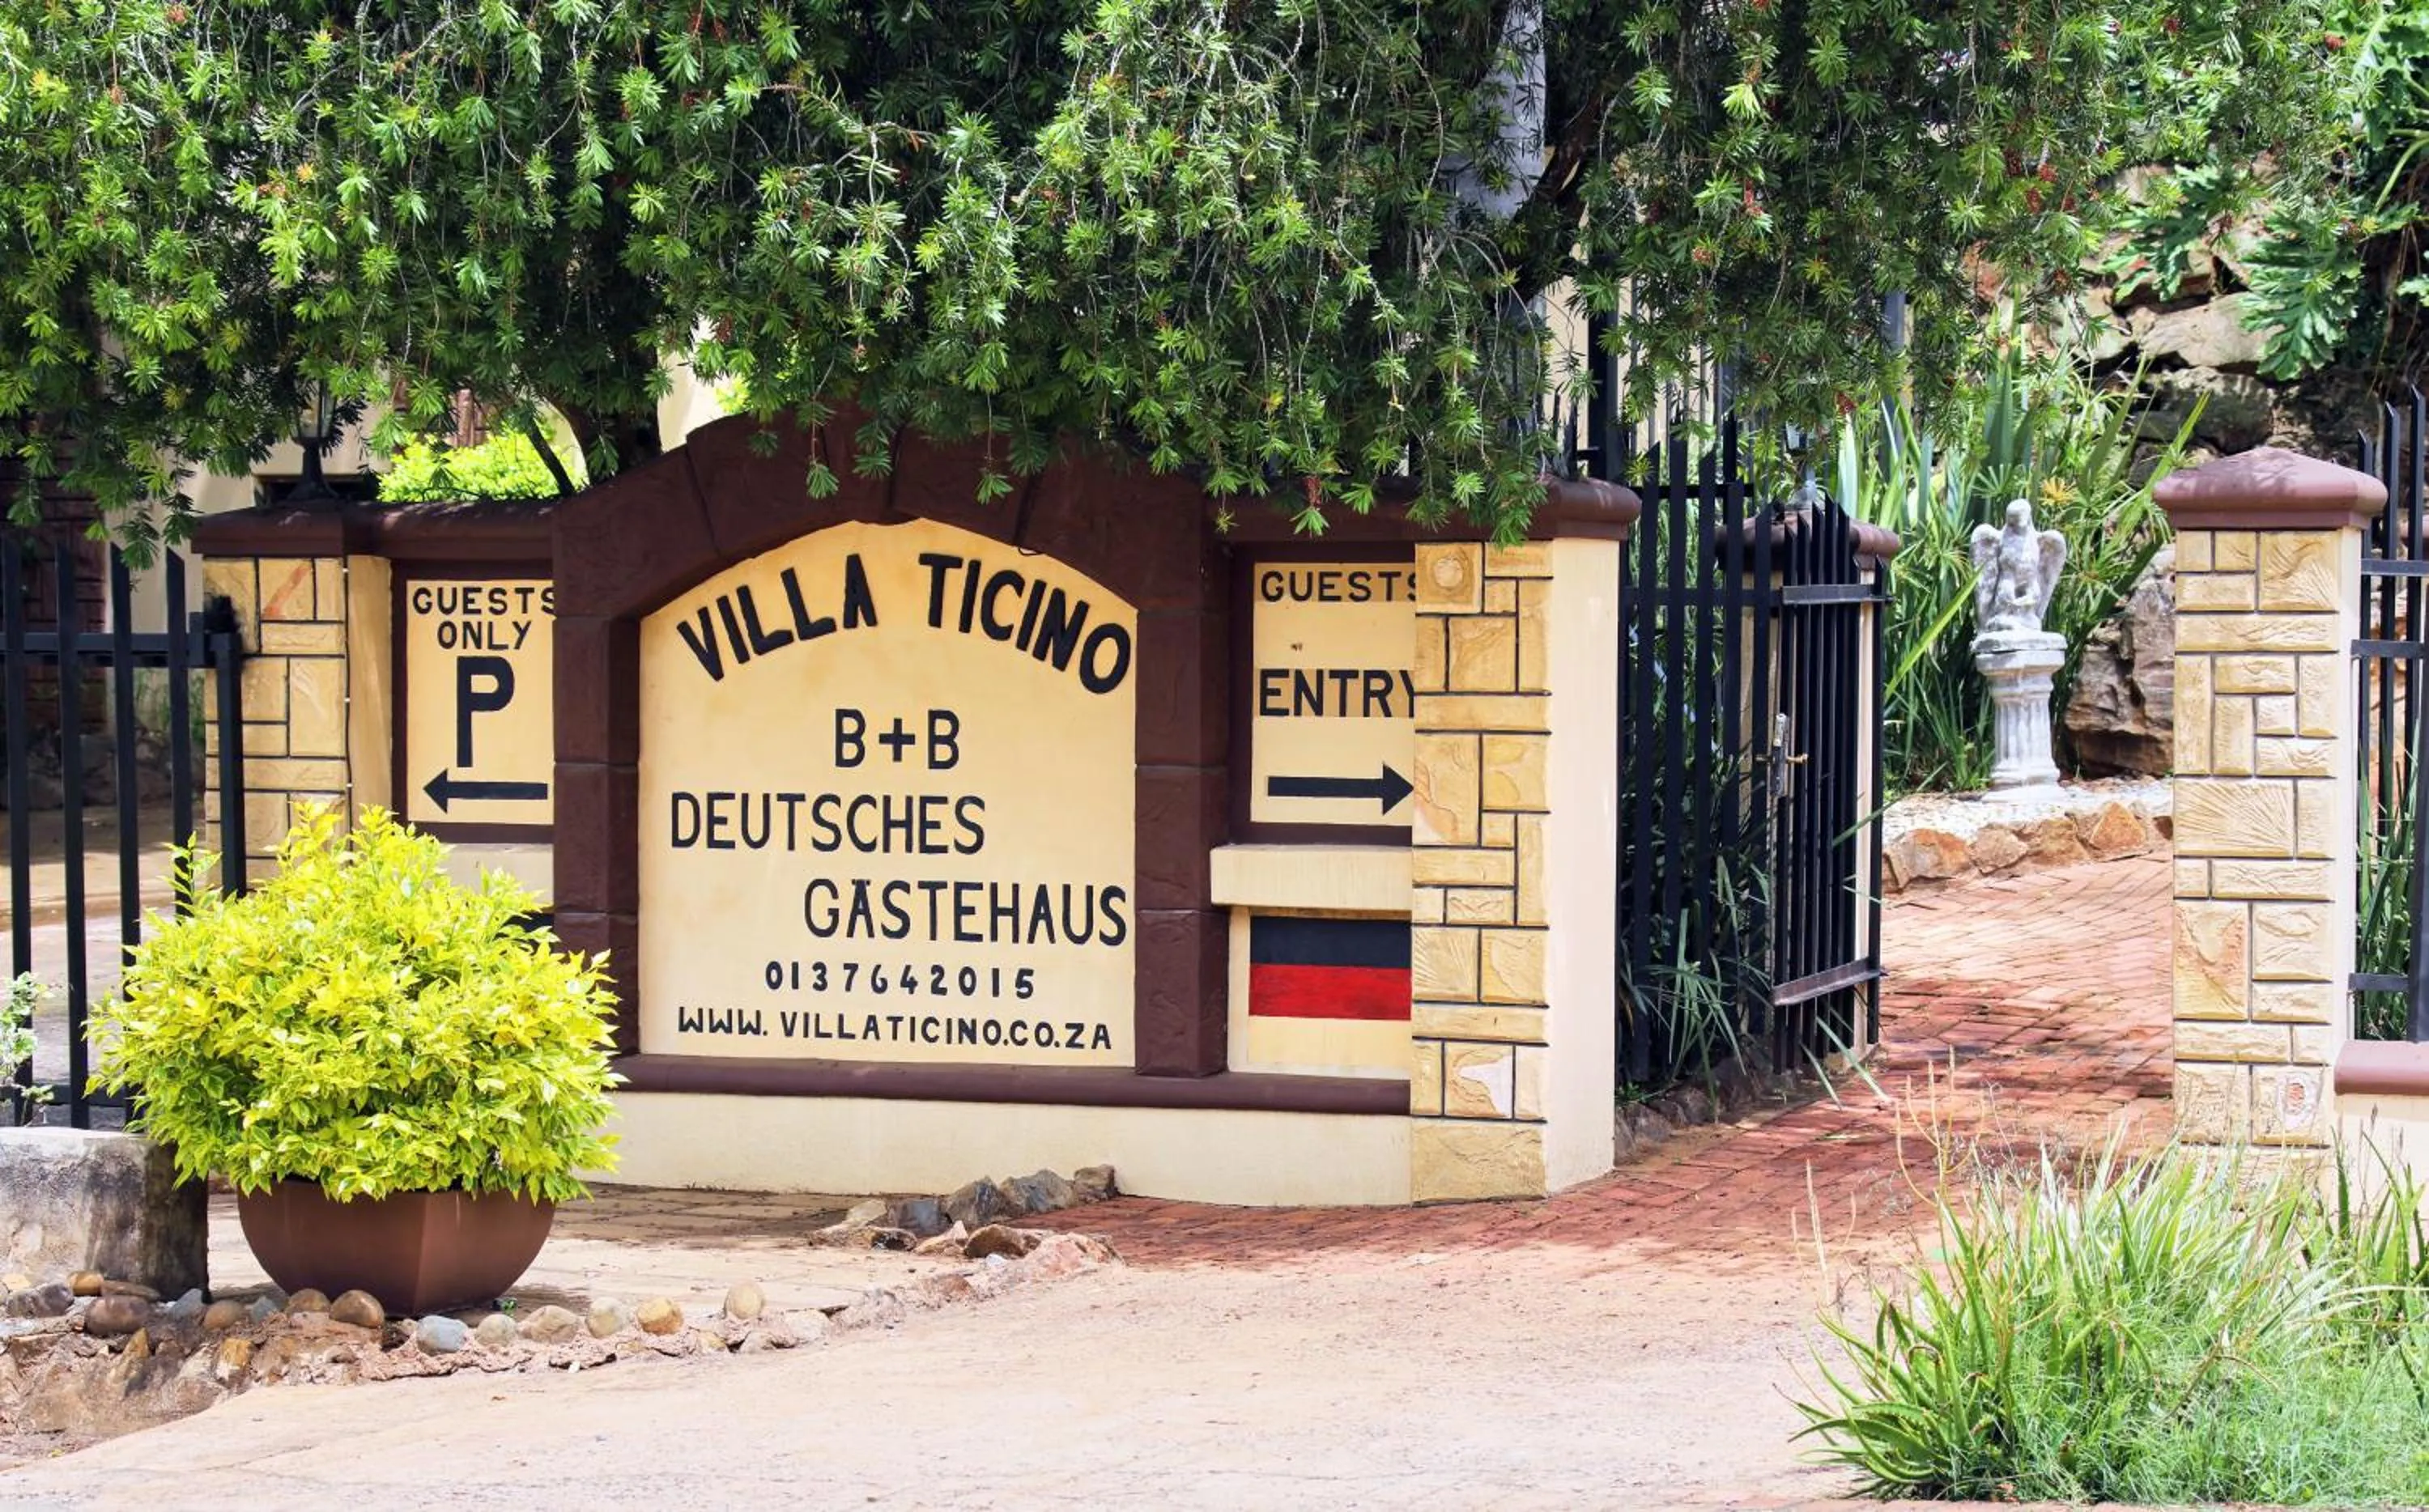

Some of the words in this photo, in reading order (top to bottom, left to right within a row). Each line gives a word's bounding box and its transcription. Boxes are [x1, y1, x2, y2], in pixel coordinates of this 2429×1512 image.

[412, 586, 555, 615] GUESTS
[676, 553, 878, 682] VILLA
[918, 552, 1132, 694] TICINO
[437, 621, 532, 650] ONLY
[456, 656, 515, 768] P
[834, 708, 961, 770] B+B
[670, 792, 986, 855] DEUTSCHES
[804, 878, 1127, 946] GÄSTEHAUS
[765, 961, 1035, 1000] 0137642015
